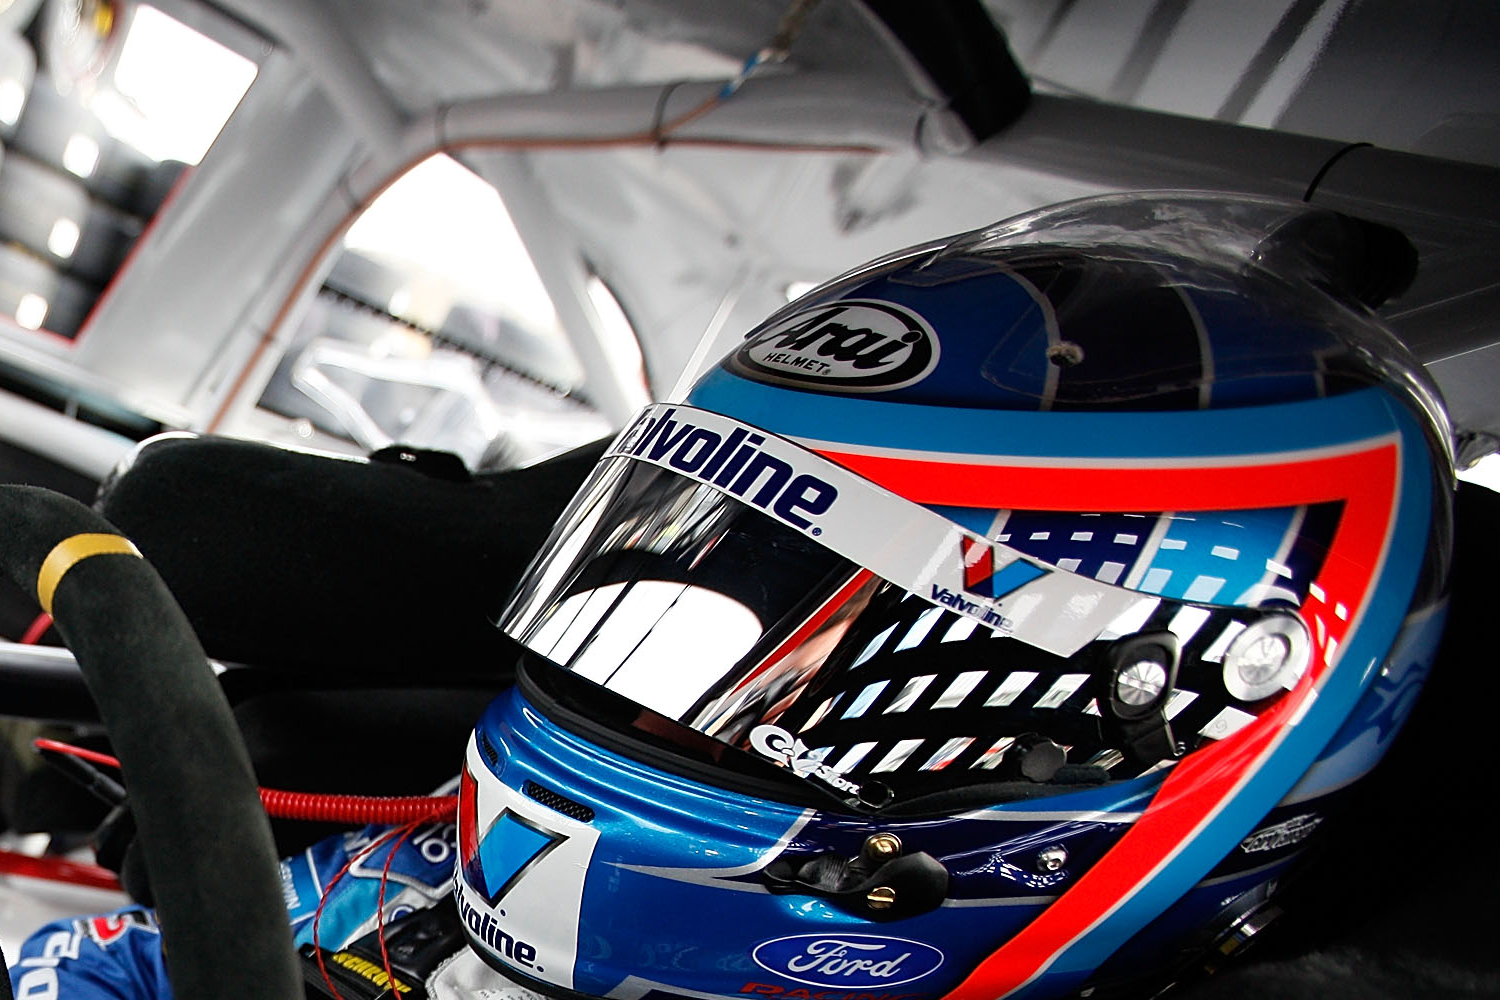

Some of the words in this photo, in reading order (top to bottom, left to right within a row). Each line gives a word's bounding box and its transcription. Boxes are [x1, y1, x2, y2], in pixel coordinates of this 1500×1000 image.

[745, 307, 923, 370] Arai
[762, 352, 830, 374] HELMET
[931, 584, 1014, 633] Valvoline
[787, 939, 912, 978] Ford
